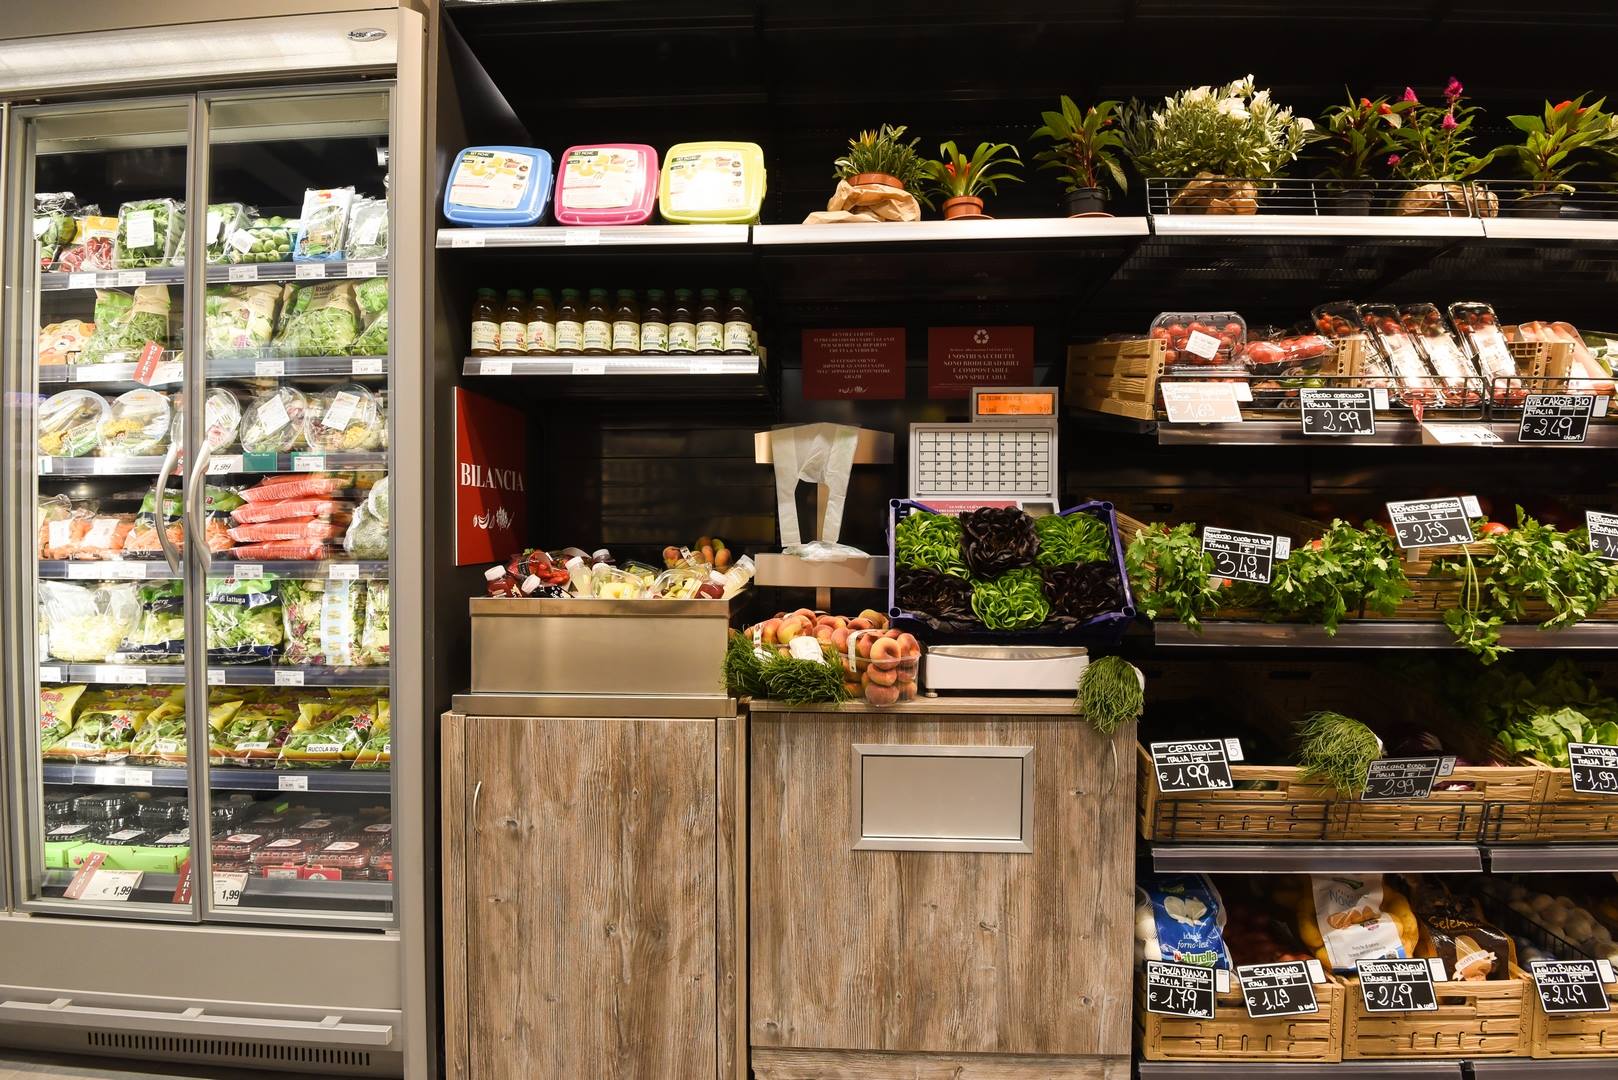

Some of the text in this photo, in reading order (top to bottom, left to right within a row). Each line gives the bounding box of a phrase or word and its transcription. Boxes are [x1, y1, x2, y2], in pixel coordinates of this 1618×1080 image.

[1305, 410, 1362, 432] € 2,99
[1522, 423, 1532, 432] €
[213, 463, 232, 472] 1,99
[460, 462, 524, 492] BILANCIA
[1400, 522, 1448, 542] € 2,59
[1592, 540, 1600, 548] €
[1217, 552, 1258, 578] 3,49
[226, 595, 246, 604] lattuga
[307, 745, 329, 753] RUCOLA
[1168, 742, 1214, 752] CETRIOLI
[1230, 744, 1239, 757] 5
[1584, 748, 1618, 756] LATTUGA
[1166, 755, 1190, 764] ITALIA
[1442, 763, 1450, 774] 9
[1160, 764, 1210, 788] € 1,99
[1574, 769, 1618, 790] € 1,99
[1378, 778, 1415, 796] 2,99
[113, 886, 132, 896] 1,99
[222, 889, 240, 902] 1,99
[1174, 950, 1218, 962] Naturella
[1152, 966, 1208, 978] CIPOLLA BIANCA
[1254, 966, 1299, 976] SCALOGNO
[1536, 966, 1558, 974] AGLIO
[1150, 976, 1180, 986] ITALIA
[1150, 992, 1158, 1002] €
[1248, 988, 1290, 1010] € 1,49
[1366, 984, 1413, 1008] € 2,49
[1543, 992, 1551, 1002] €
